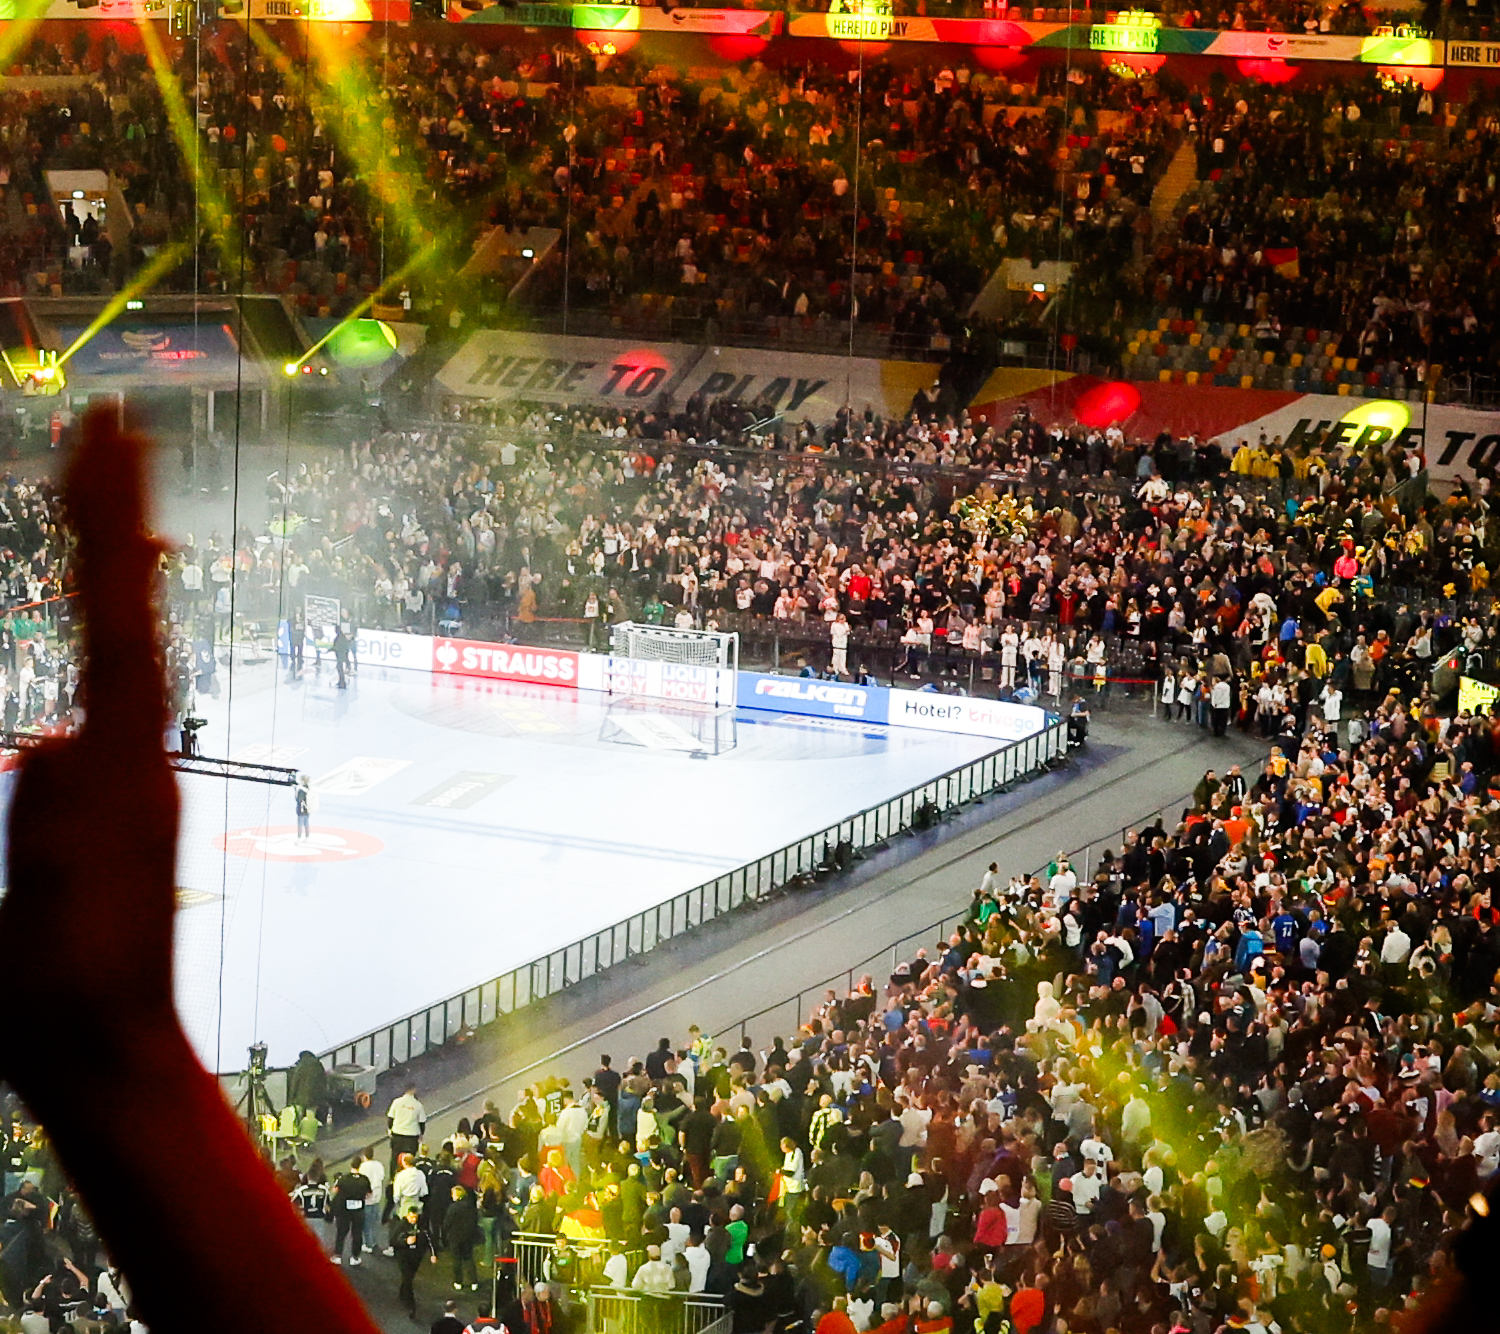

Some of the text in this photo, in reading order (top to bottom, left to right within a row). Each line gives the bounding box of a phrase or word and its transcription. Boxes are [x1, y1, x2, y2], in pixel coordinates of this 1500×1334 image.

[266, 0, 292, 15] HERE
[833, 19, 908, 38] HERE TO PLAY
[1109, 30, 1123, 45] TO
[1128, 30, 1156, 48] PLAY
[1451, 45, 1482, 62] HERE
[1485, 47, 1500, 63] TO
[467, 354, 830, 411] HERE TO PLAY
[354, 633, 403, 662] enje
[462, 647, 575, 682] STRAUSS
[602, 657, 647, 678] LIQUI
[661, 663, 707, 685] LIQUI
[602, 673, 647, 695] MOLY
[661, 679, 707, 702] MOLY
[754, 678, 868, 708] FALKEN
[904, 699, 1036, 735] Hotel? trivago
